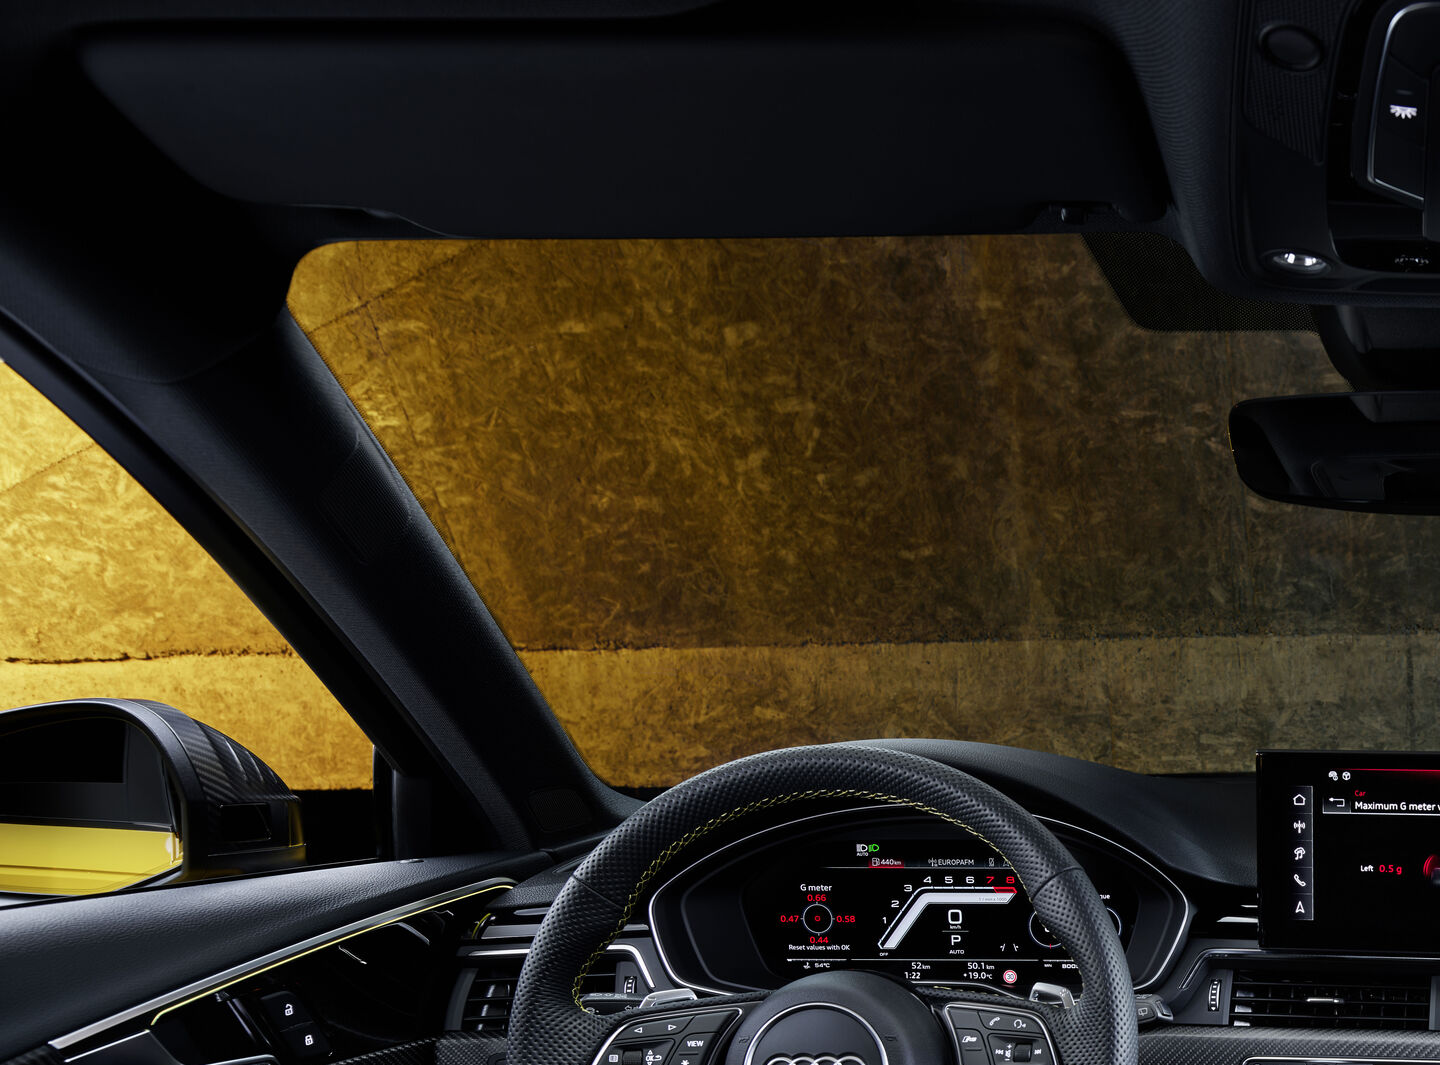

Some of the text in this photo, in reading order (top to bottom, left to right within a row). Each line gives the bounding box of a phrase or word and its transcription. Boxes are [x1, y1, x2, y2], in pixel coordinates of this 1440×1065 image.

[1354, 801, 1398, 810] Maximum
[1400, 802, 1407, 811] G
[1408, 803, 1436, 811] meter
[1360, 864, 1403, 875] Left 0.5 g
[923, 876, 932, 884] 4
[944, 876, 953, 884] 5
[965, 876, 974, 884] 6
[986, 876, 995, 884] 7
[1006, 876, 1015, 884] 8
[807, 894, 827, 902] 0.66
[891, 900, 900, 908] 2
[780, 915, 799, 923] 0.47
[836, 915, 856, 923] 0.58
[882, 916, 887, 924] 1
[947, 909, 962, 924] 0
[809, 936, 829, 944] 0.44
[951, 935, 961, 946] P
[967, 962, 985, 970] 50.1
